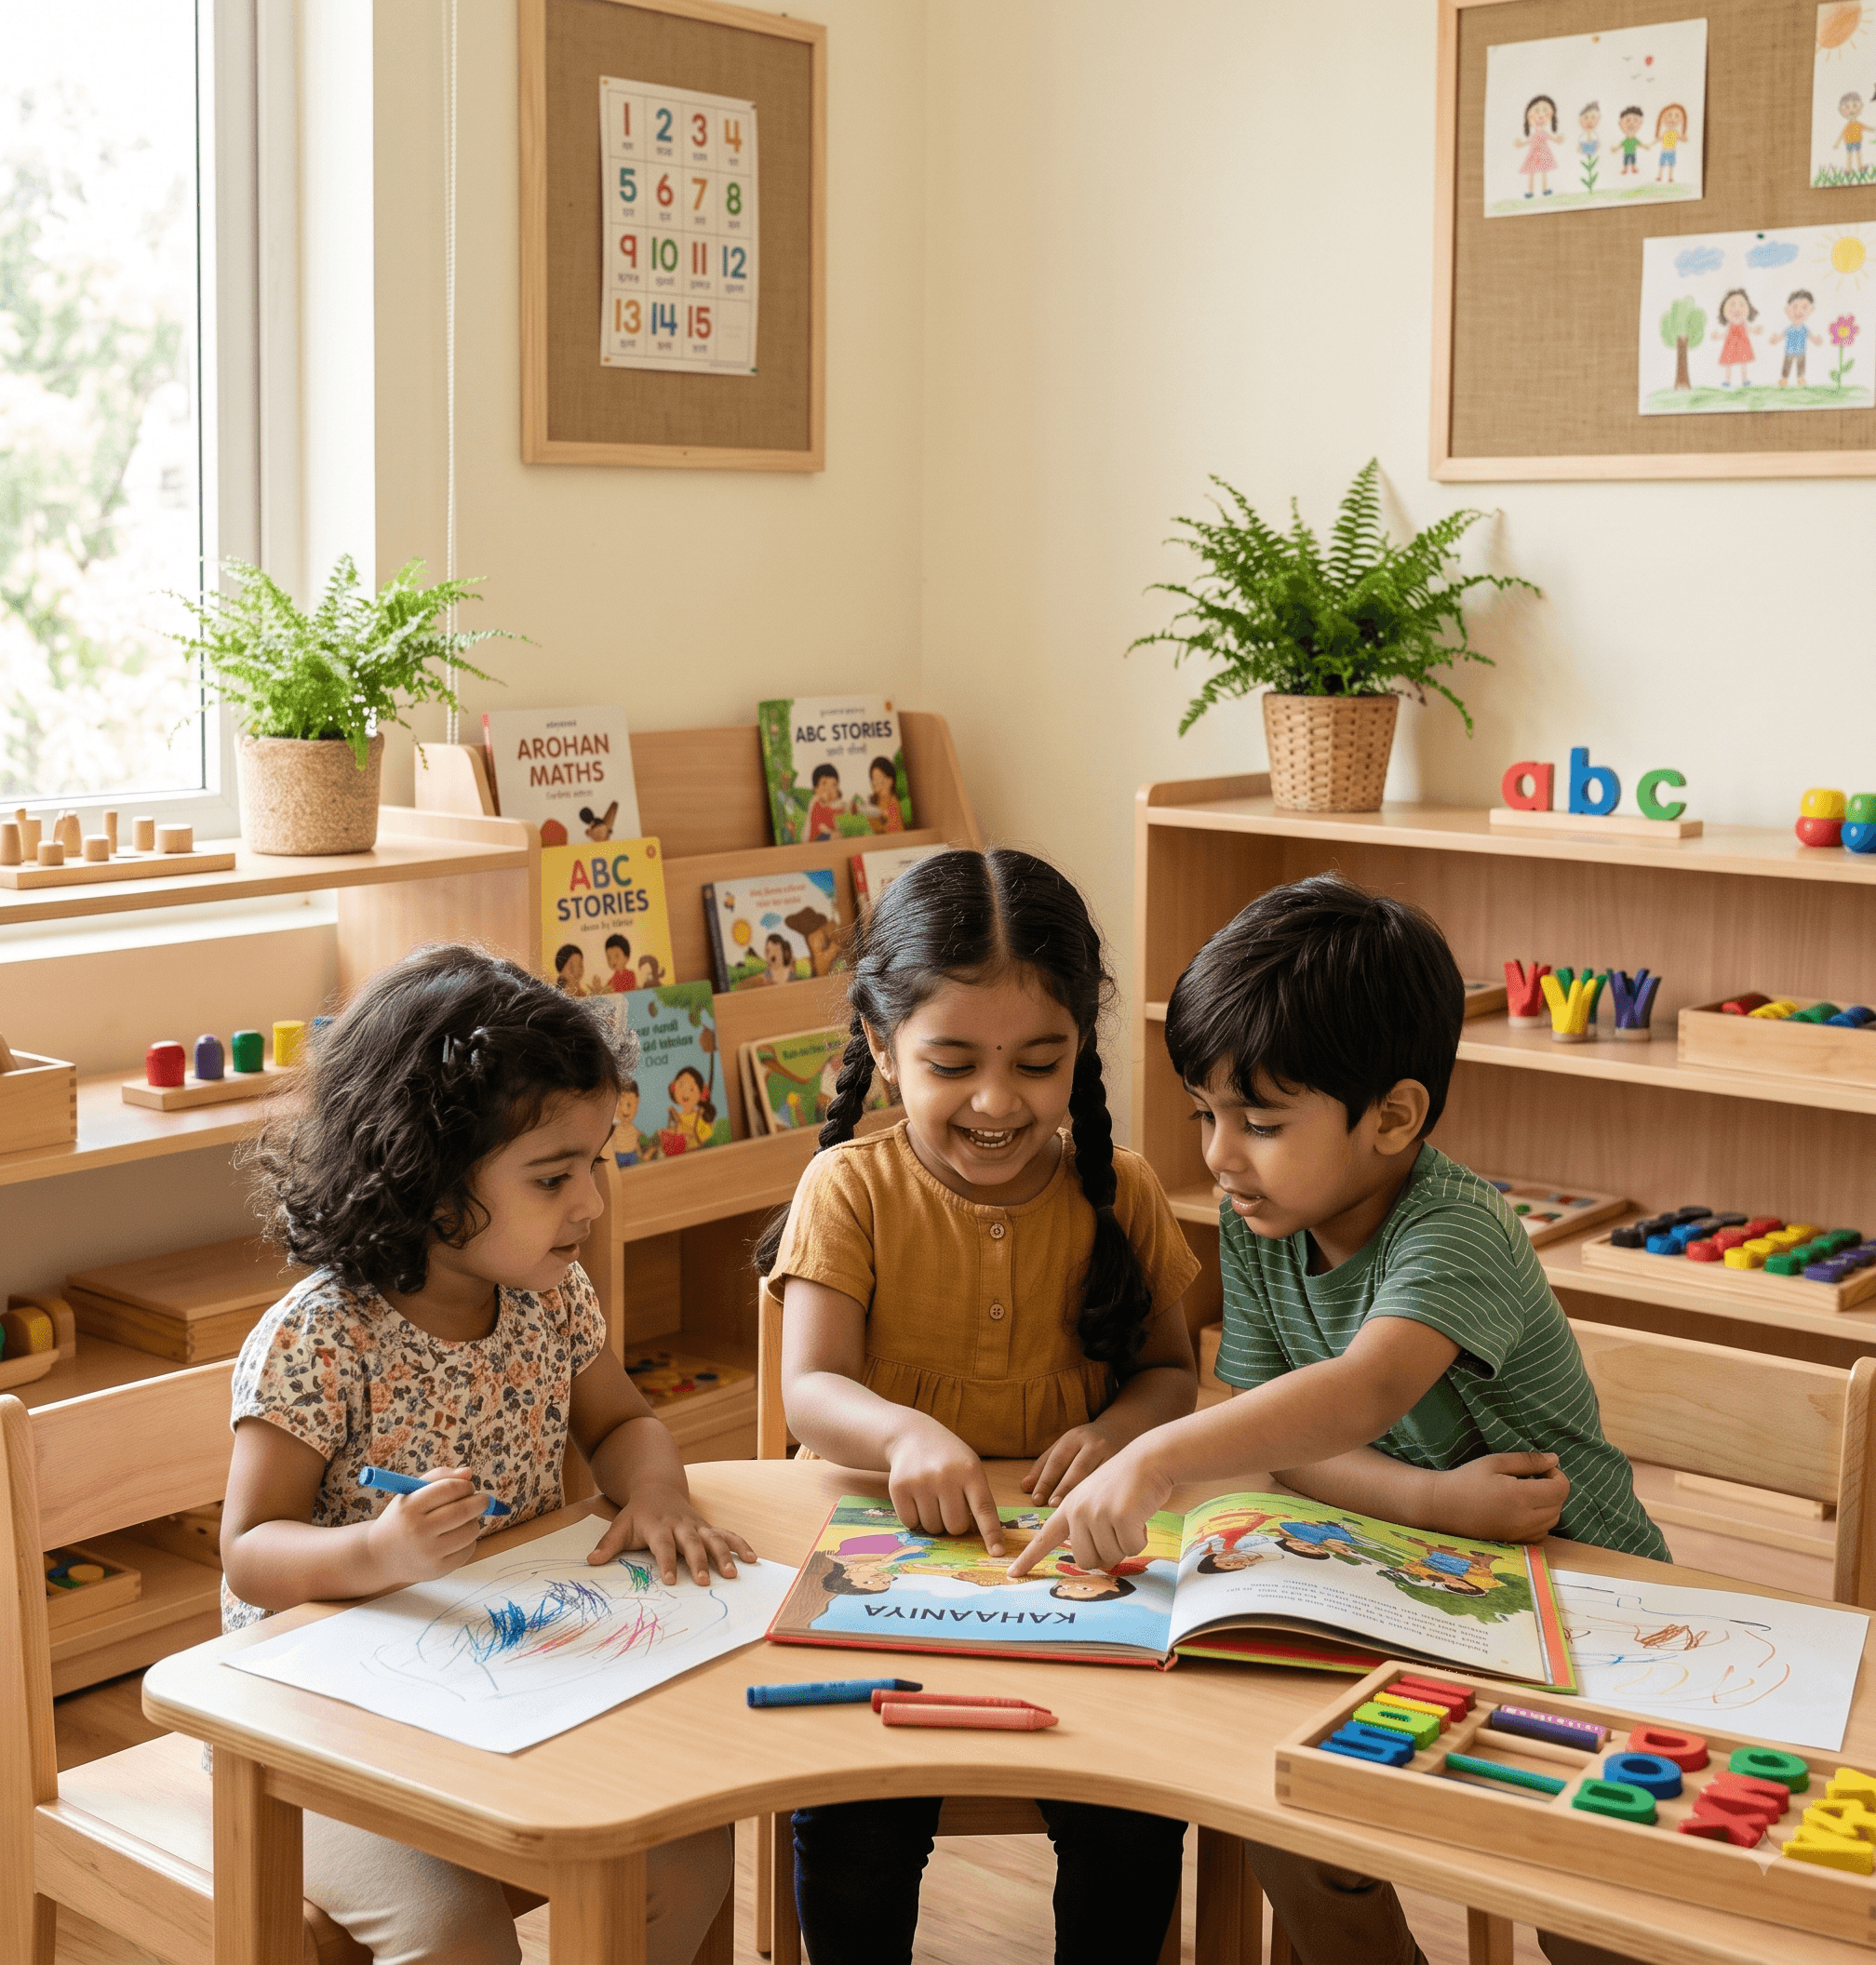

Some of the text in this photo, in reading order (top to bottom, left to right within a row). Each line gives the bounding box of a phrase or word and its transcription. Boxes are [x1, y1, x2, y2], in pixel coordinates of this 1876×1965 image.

[623, 101, 742, 153] 1 2 3 4
[619, 167, 742, 216] 5 6 7 8
[620, 234, 746, 279] 9 10 11 12
[615, 298, 712, 339] 13 14 15
[517, 733, 610, 761] AROHAN
[796, 720, 892, 742] ABC STORIES
[529, 760, 604, 786] MATHS
[570, 854, 632, 891] ABC
[557, 889, 650, 921] STORIES
[864, 1604, 1077, 1624] KAHAANIYA
